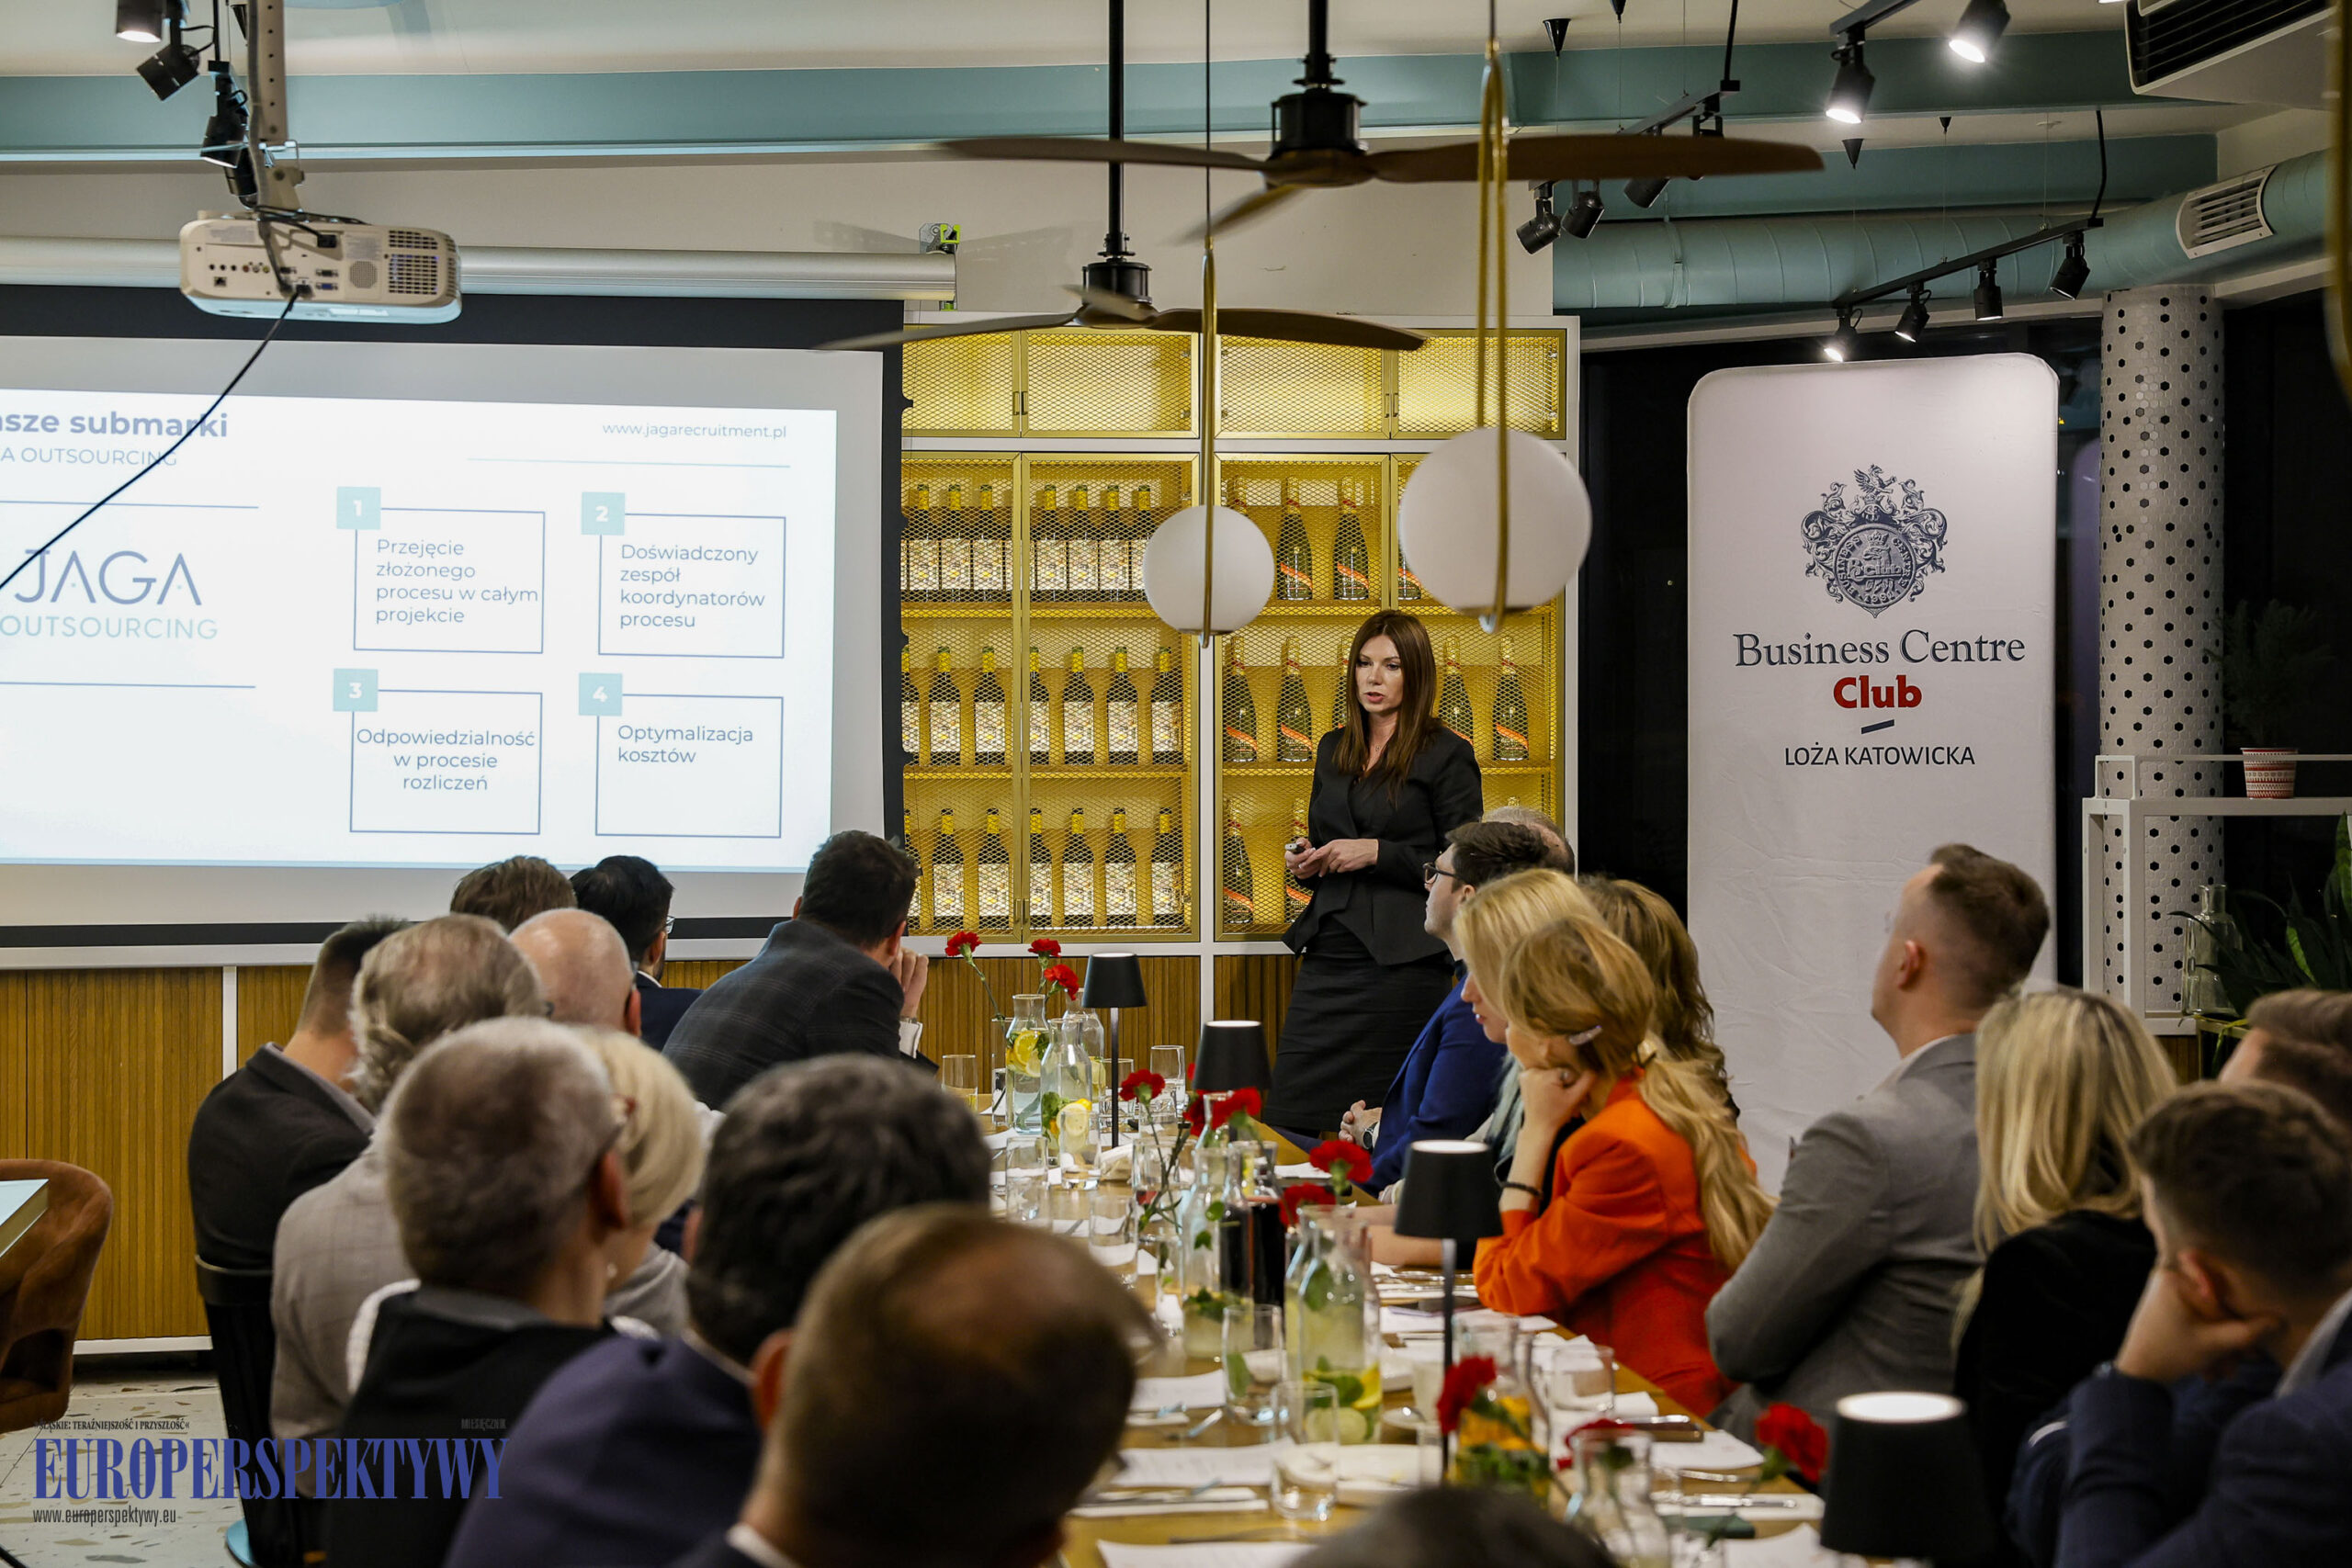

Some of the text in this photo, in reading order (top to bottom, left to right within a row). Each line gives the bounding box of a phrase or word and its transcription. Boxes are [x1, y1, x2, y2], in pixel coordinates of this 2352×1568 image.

[0, 411, 228, 437] sze submarki
[602, 423, 787, 440] www.jagarecruitment.pl
[21, 447, 177, 466] OUTSOURCING
[353, 500, 363, 516] 1
[595, 505, 609, 522] 2
[377, 538, 465, 558] Przejęcie
[621, 544, 759, 565] Doświadczony
[15, 548, 203, 606] JAGA
[376, 561, 476, 581] złożonego
[620, 567, 681, 585] zespół
[376, 586, 539, 604] procesu w całym
[620, 589, 766, 609] koordynatorów
[376, 606, 465, 626] projekcie
[619, 614, 695, 630] procesu
[0, 615, 219, 639] OUTSOURCING
[1733, 629, 2026, 667] Business Centre
[349, 682, 363, 699] 3
[593, 687, 608, 703] 4
[1833, 674, 1923, 709] Club
[356, 728, 536, 749] Odpowiedzialność
[617, 725, 753, 745] Optymalizacja
[393, 751, 498, 770] w procesie
[617, 747, 696, 764] kosztów
[1785, 741, 1975, 765] LOŻA KATOWICKA
[402, 773, 489, 791] rozliczeń
